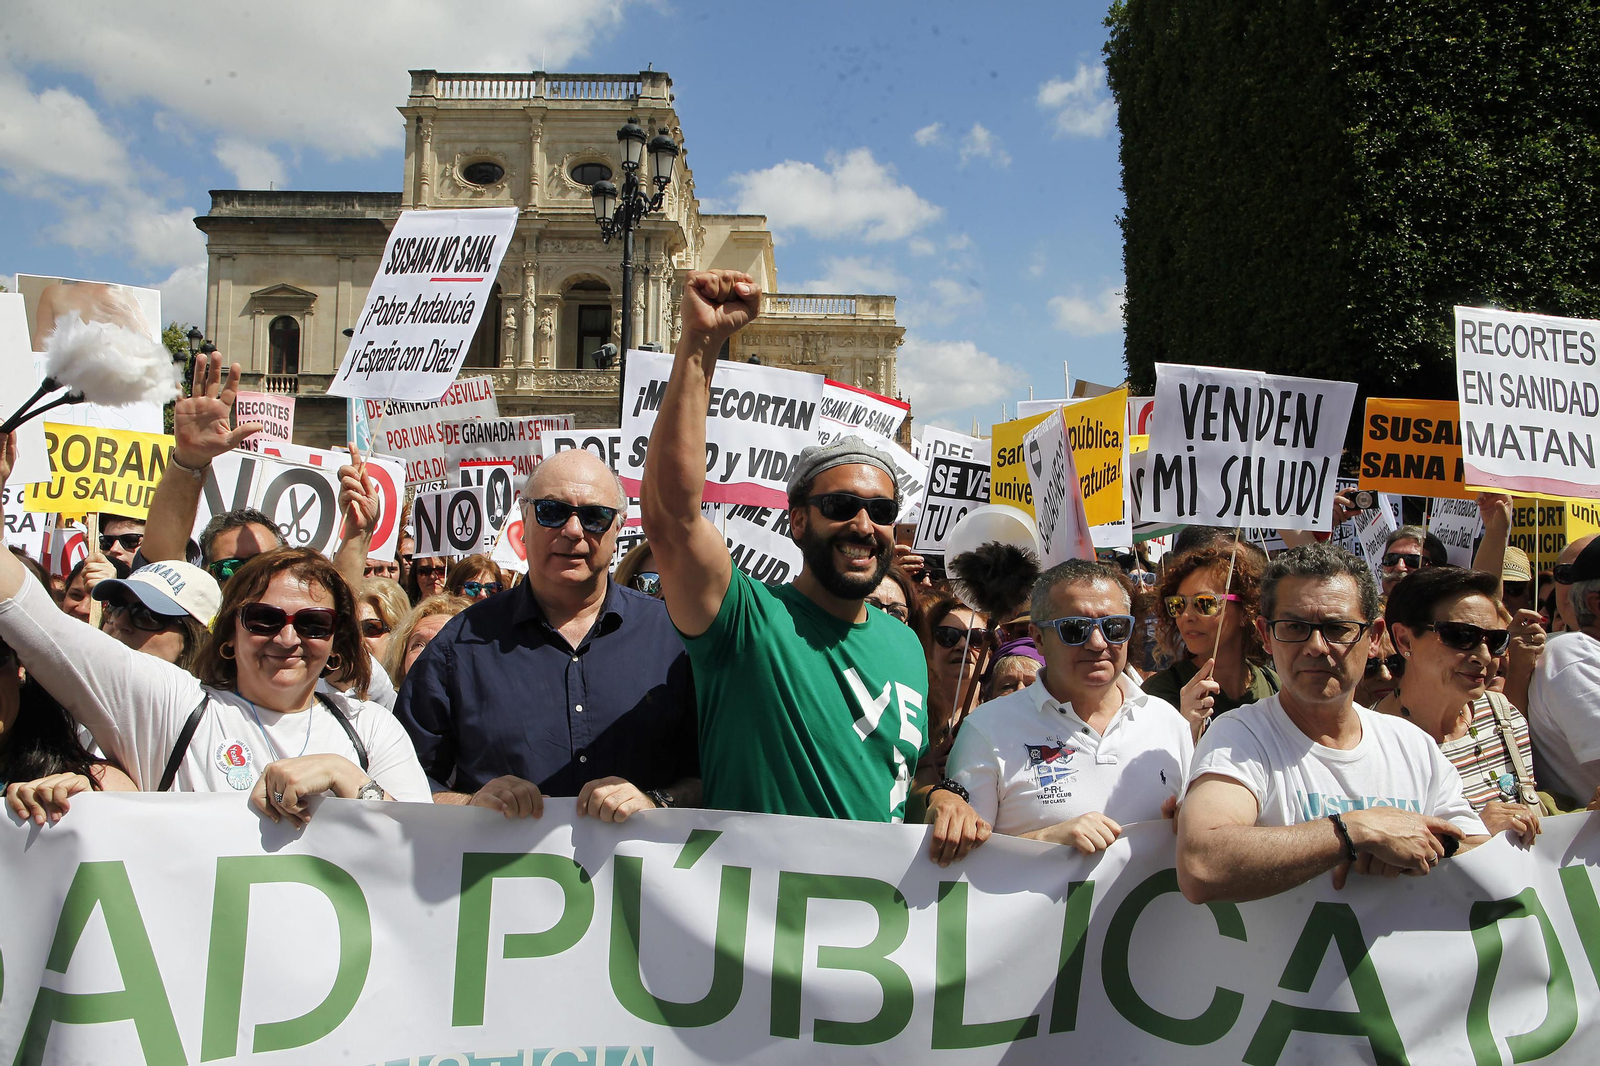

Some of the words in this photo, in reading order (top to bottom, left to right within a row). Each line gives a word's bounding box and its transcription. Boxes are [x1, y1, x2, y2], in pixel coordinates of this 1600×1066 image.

[385, 237, 439, 275] SUSANA
[431, 236, 460, 274] NO
[403, 293, 475, 326] Andalucía
[342, 348, 362, 382] y
[355, 340, 399, 381] España
[397, 344, 424, 373] con
[420, 338, 464, 373] Díaz!
[1460, 319, 1597, 367] RECORTES
[238, 401, 290, 422] RECORTES
[366, 400, 383, 420] DE
[448, 383, 493, 407] SEVILLA
[632, 379, 667, 417] ¡M
[705, 386, 816, 431] ECORTAN
[1462, 369, 1494, 406] EN
[1499, 372, 1600, 417] SANIDAD
[445, 424, 461, 444] DE
[462, 421, 516, 444] GRANADA
[517, 420, 526, 440] A
[847, 404, 868, 425] NO
[1179, 383, 1325, 449] VENDEN
[386, 427, 411, 451] POR
[409, 424, 437, 447] UNA
[1068, 415, 1123, 453] pública,
[1466, 420, 1596, 469] MATAN
[719, 451, 741, 483] y
[895, 465, 924, 501] TAN
[932, 463, 961, 496] SE
[965, 468, 991, 499] VE
[995, 477, 1035, 506] unive
[1079, 457, 1122, 500] ratuita!
[1362, 451, 1446, 481] SANA
[1216, 455, 1331, 525] SALUD!
[414, 489, 482, 555] NO
[923, 503, 953, 542] TU
[1511, 506, 1565, 528] RECORT
[1509, 533, 1567, 553] HOMICID
[5, 859, 373, 1066] AD
[451, 828, 1409, 1066] PÚBLICA
